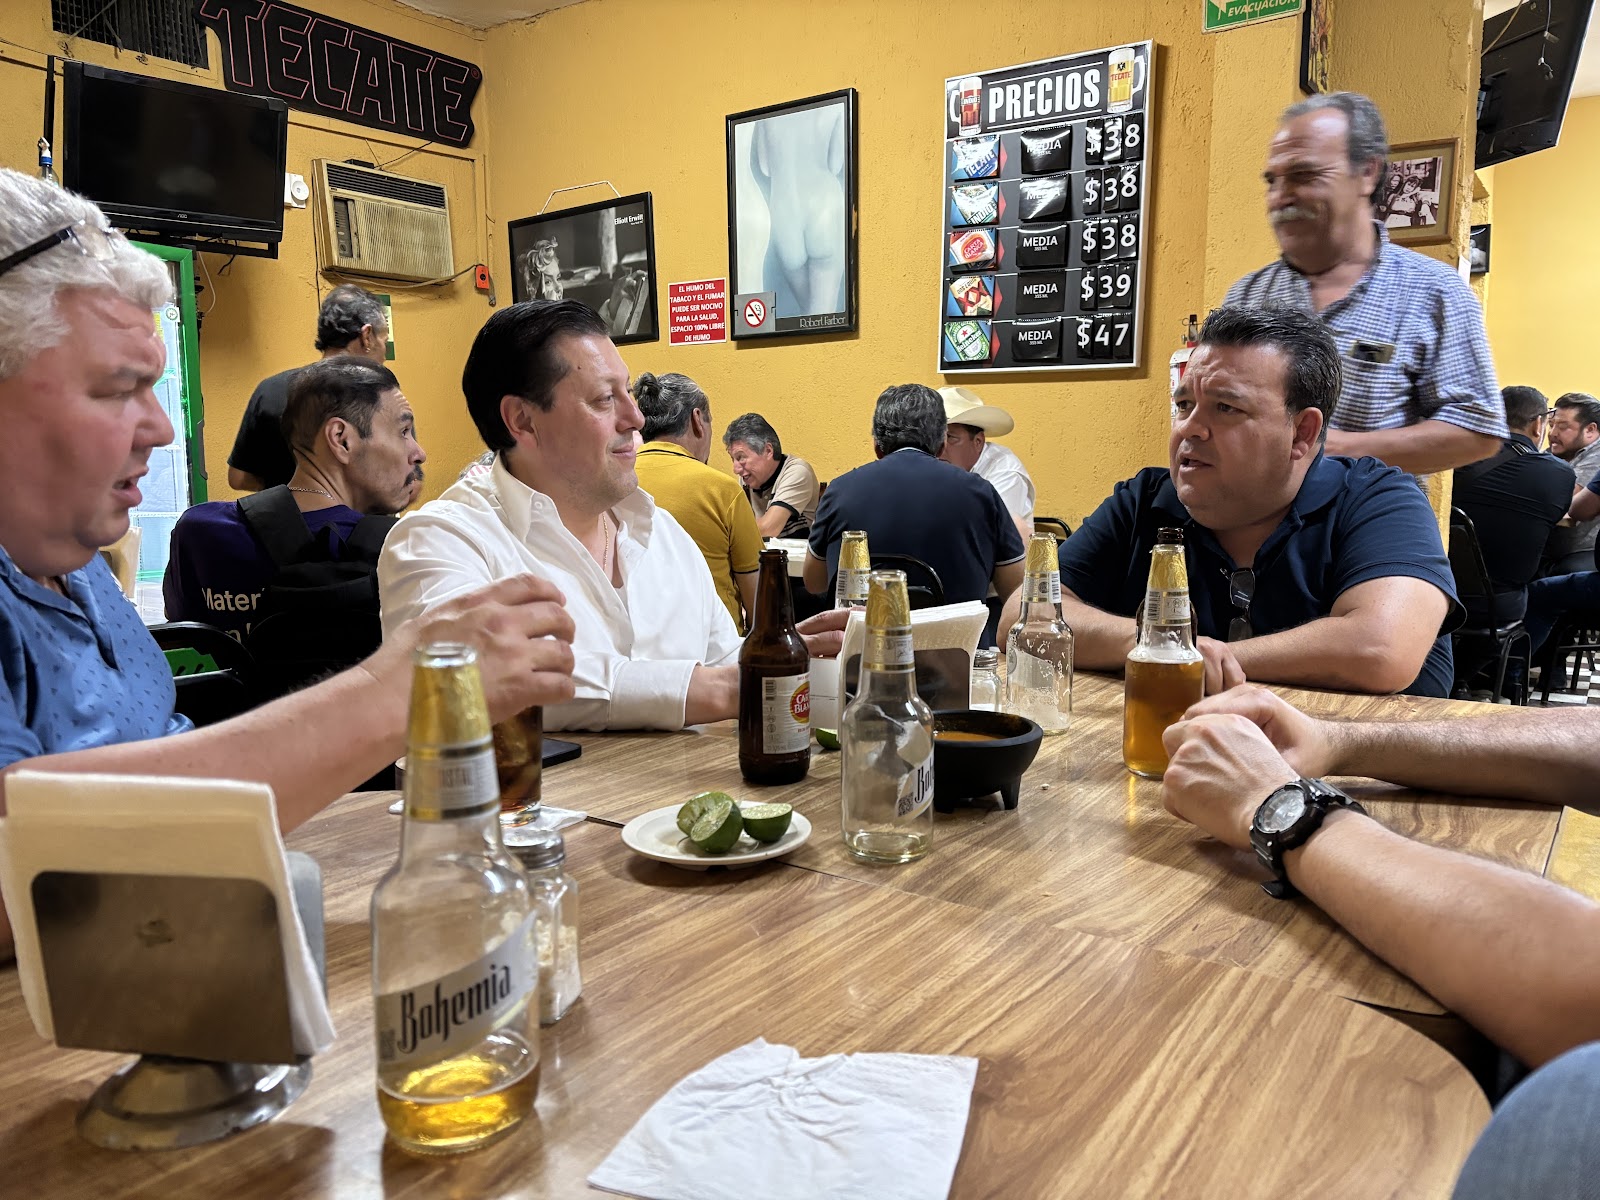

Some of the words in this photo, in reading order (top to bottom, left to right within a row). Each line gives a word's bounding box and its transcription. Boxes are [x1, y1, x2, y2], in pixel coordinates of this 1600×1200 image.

[200, 0, 469, 141] TECATE
[989, 69, 1101, 123] PRECIOS
[1086, 123, 1140, 155] $38
[1085, 174, 1138, 205] $38
[1023, 236, 1058, 247] MEDIA
[1082, 223, 1136, 253] $38
[670, 295, 691, 303] TABACO
[705, 292, 724, 300] FUMAR
[686, 284, 704, 292] HUMO
[1023, 283, 1058, 295] MEDIA
[1081, 271, 1131, 301] $39
[701, 302, 723, 310] NOCIVO
[671, 325, 693, 333] ESPACIO
[694, 323, 708, 331] 100%
[709, 322, 725, 330] LIBRE
[1018, 330, 1053, 341] MEDIA
[1077, 320, 1129, 348] $47
[201, 587, 265, 611] Mater
[397, 964, 511, 1054] Bohemia
